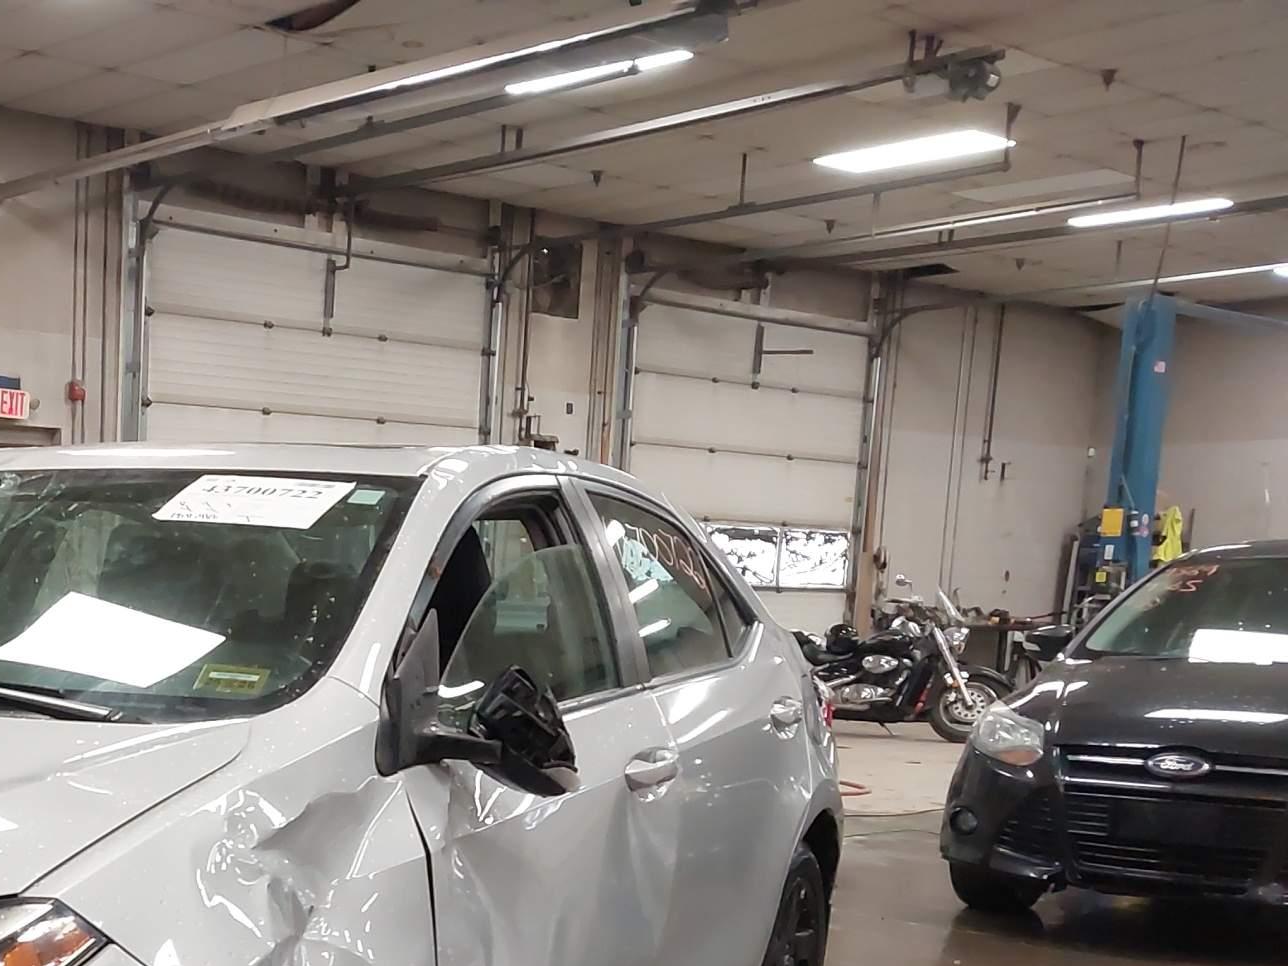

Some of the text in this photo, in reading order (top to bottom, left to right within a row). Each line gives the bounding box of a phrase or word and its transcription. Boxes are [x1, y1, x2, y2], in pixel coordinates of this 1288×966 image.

[0, 390, 25, 416] EXIT
[202, 484, 325, 499] 43700722
[1159, 758, 1195, 771] Ford
